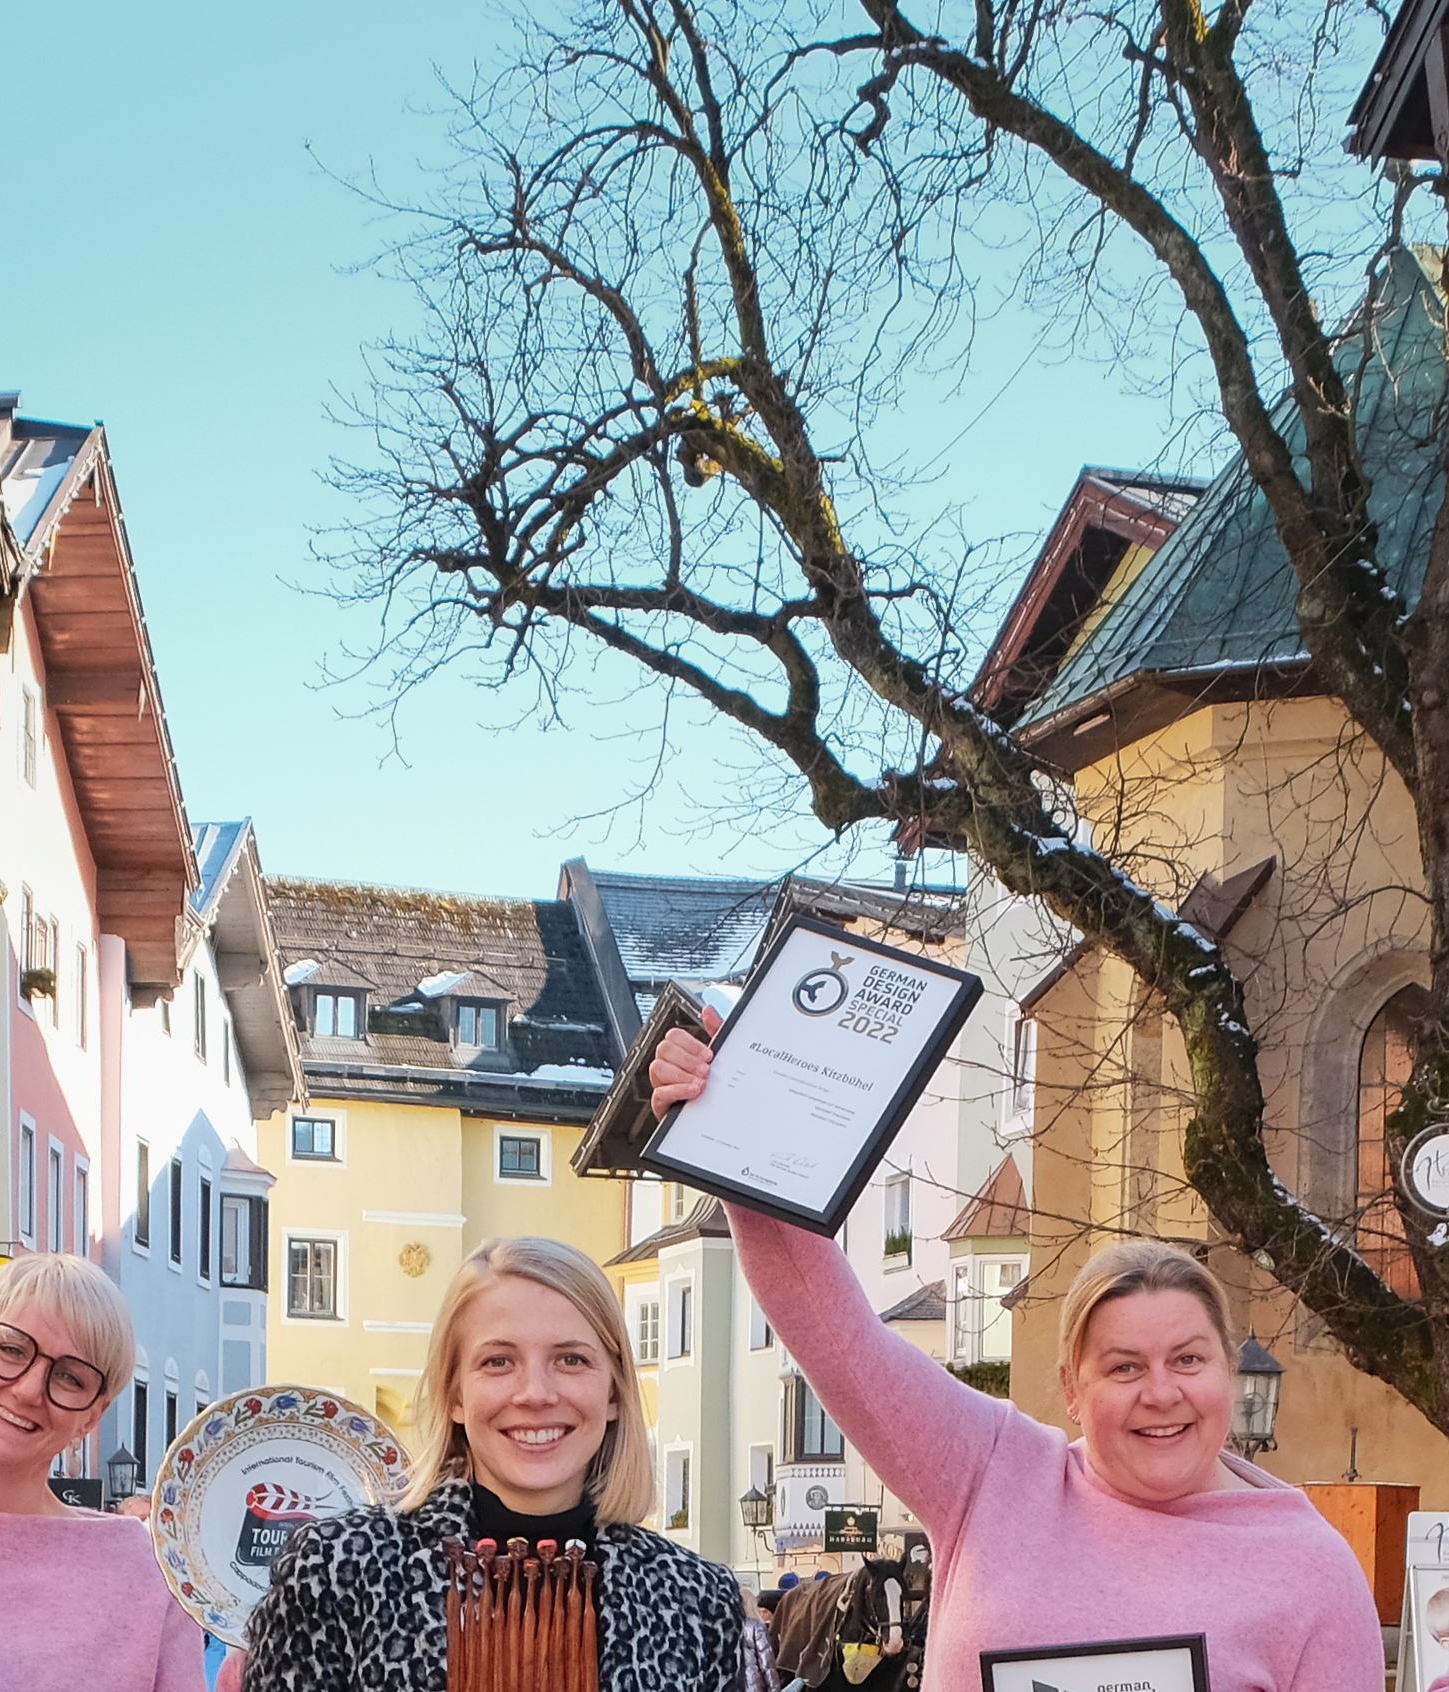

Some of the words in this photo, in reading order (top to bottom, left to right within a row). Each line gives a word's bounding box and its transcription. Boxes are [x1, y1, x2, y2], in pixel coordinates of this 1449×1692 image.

[863, 976, 921, 1003] DESIGN
[870, 965, 928, 991] GERMAN
[849, 1000, 903, 1027] SPECIAL
[854, 989, 913, 1016] AWARD
[837, 1011, 899, 1044] 2022
[821, 1066, 874, 1092] Kitzbühel
[241, 1456, 293, 1475] International
[295, 1457, 325, 1475] Tourism
[252, 1528, 288, 1545] TOUR
[250, 1547, 272, 1557] FILM
